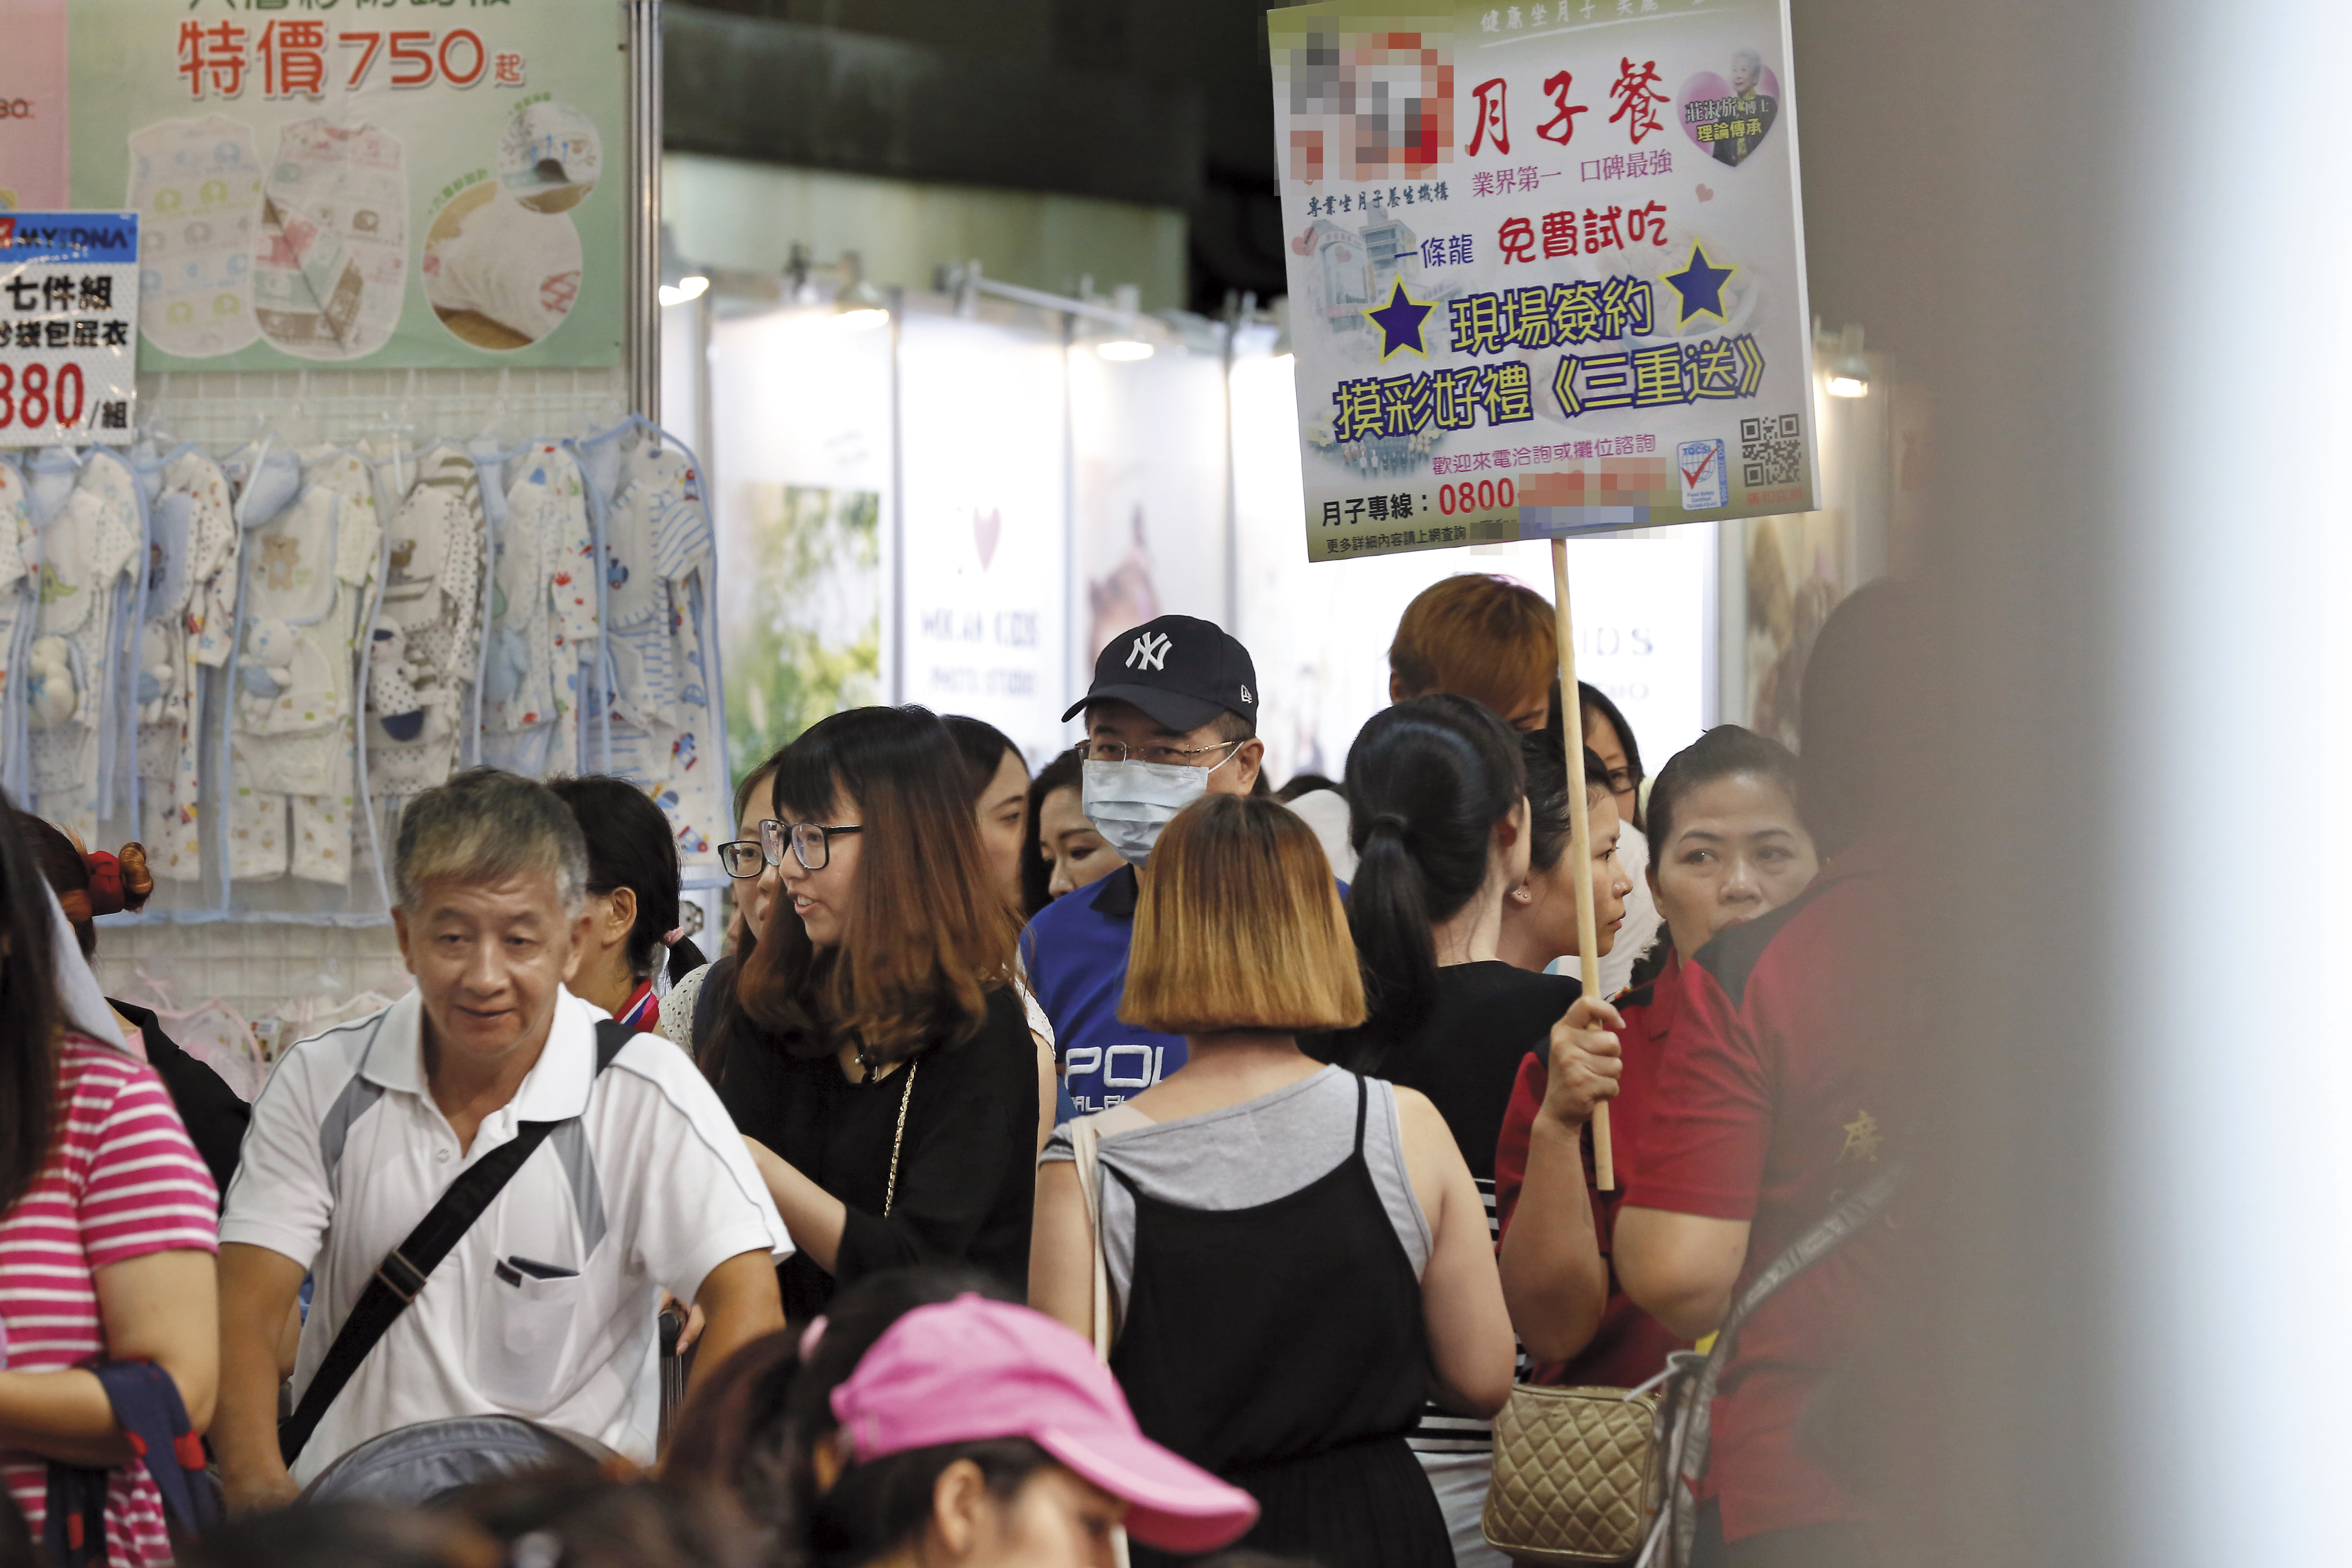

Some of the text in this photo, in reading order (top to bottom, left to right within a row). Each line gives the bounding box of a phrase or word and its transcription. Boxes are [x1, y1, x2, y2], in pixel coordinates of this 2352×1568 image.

[1464, 56, 1671, 157] 月子餐
[1696, 117, 1762, 143] 理論傳承
[1472, 149, 1674, 198] 業界第一 口碑最強
[1394, 234, 1474, 269] 一條龍
[1497, 199, 1668, 265] 免費試吃
[6, 274, 112, 311] 七件組
[1448, 274, 1655, 357] 現場簽約
[1333, 360, 1534, 443] 摸彩好禮
[1432, 433, 1657, 475] 歡迎來電洽詢或攤位諮詢
[1326, 526, 1467, 554] 更多詳細內容請上網查詢
[1125, 631, 1173, 671] NY
